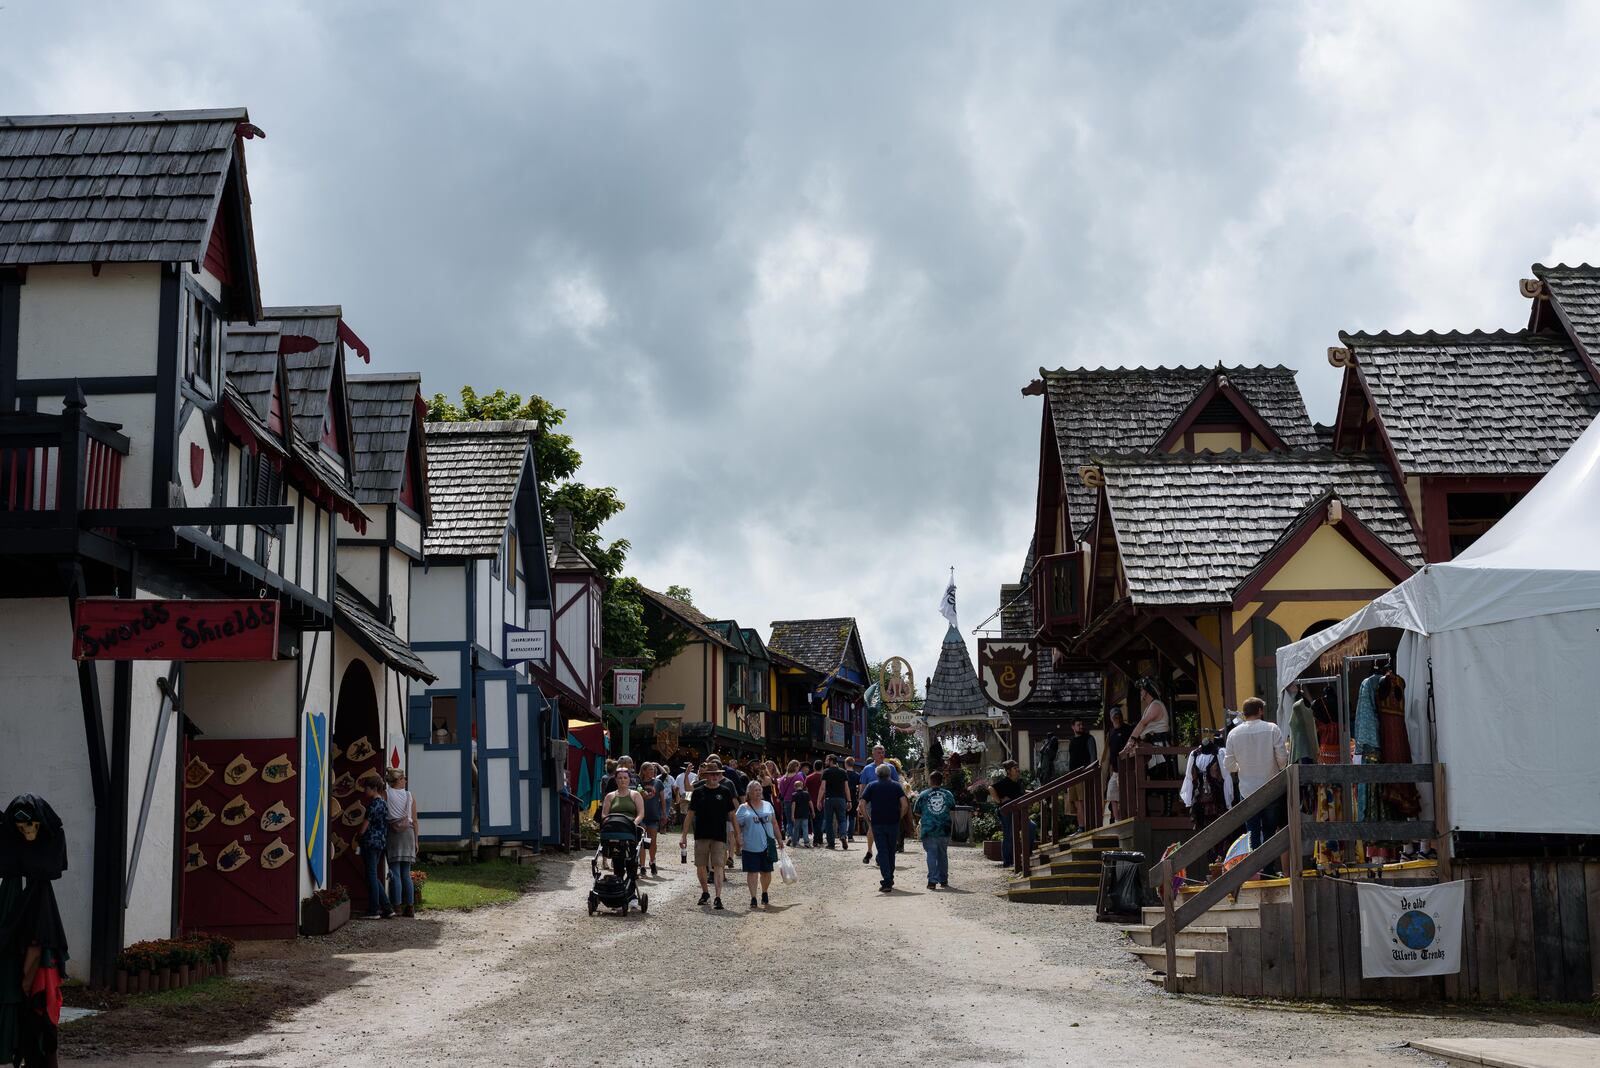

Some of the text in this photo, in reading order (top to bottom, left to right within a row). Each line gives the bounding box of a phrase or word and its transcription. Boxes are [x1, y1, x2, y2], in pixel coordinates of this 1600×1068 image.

[77, 602, 169, 656] Swords
[176, 603, 274, 648] Shields
[1401, 896, 1411, 910] Ye
[1392, 949, 1446, 960] World Trendz
